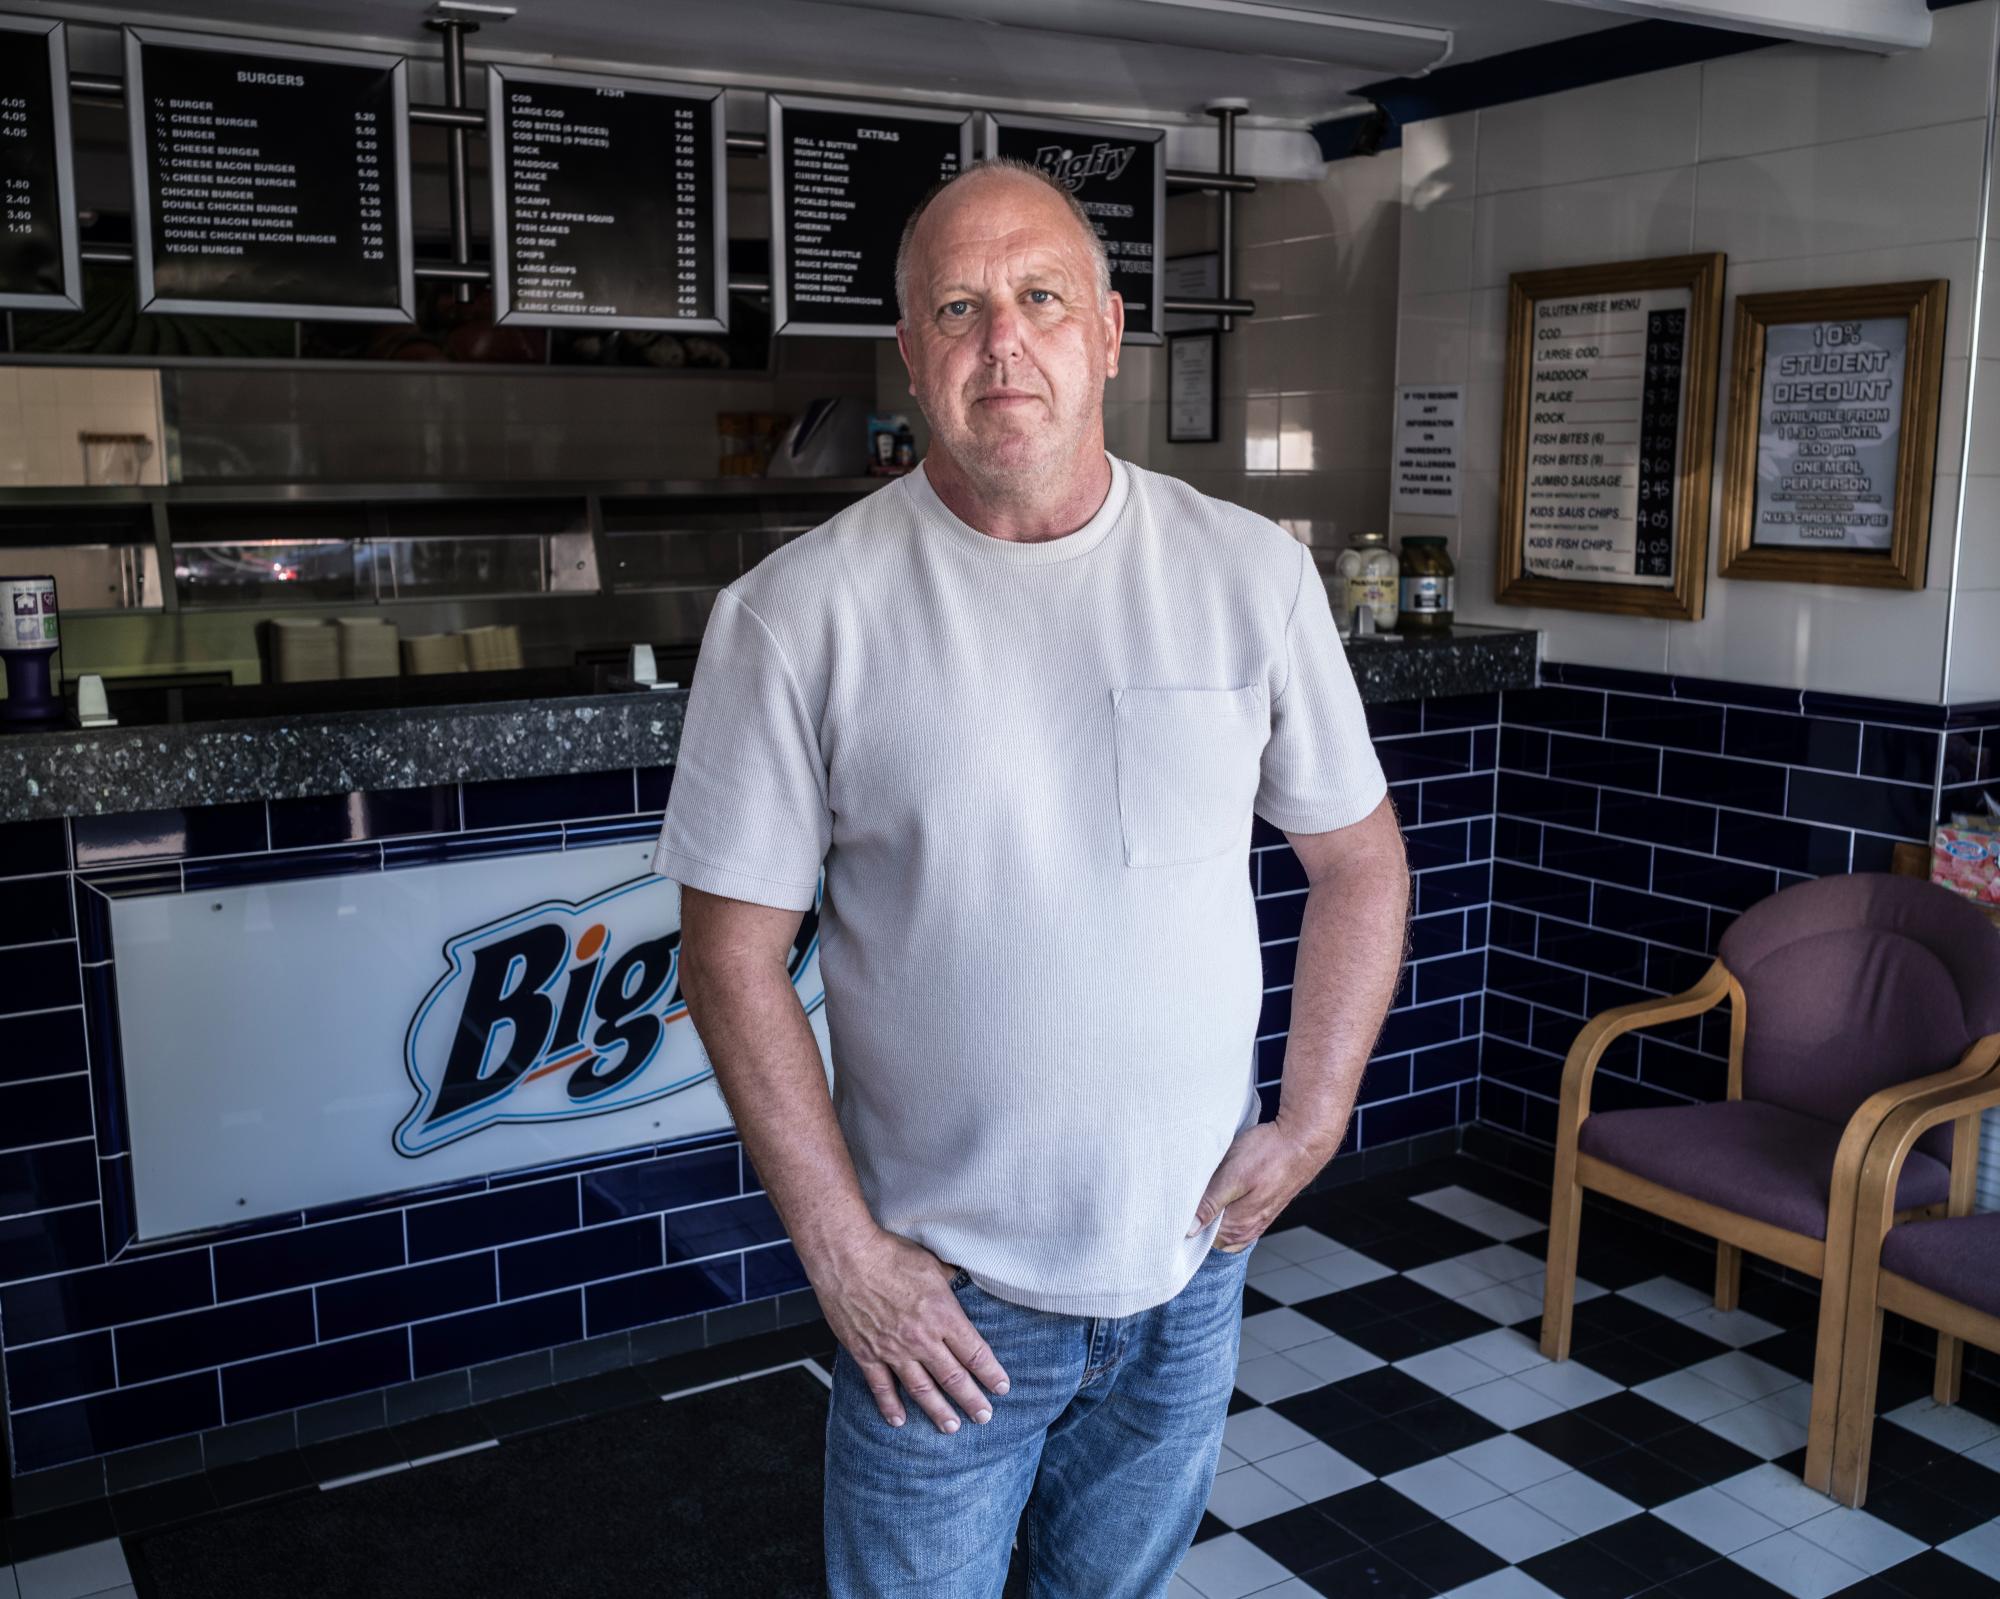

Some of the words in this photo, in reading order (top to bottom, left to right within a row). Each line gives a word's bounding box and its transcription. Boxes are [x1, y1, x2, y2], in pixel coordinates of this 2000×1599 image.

[237, 71, 305, 87] BURGERS
[1, 98, 26, 108] 4.05
[170, 99, 213, 110] BURGER
[511, 94, 532, 103] COD
[2, 111, 26, 121] 4.05
[512, 106, 542, 116] LARGE
[544, 109, 564, 118] COD
[171, 114, 213, 125] CHEESE
[215, 117, 258, 128] BURGER
[512, 120, 532, 128] COD
[534, 122, 561, 131] BITES
[3, 127, 28, 137] 4.05
[172, 129, 215, 140] BURGER
[513, 132, 532, 140] COD
[535, 134, 562, 143] BITES
[857, 129, 899, 141] EXTRAS
[173, 144, 215, 154] CHEESE
[217, 146, 260, 157] BURGER
[513, 146, 540, 154] ROCK
[171, 158, 212, 169] CHEESE
[215, 161, 251, 171] BACON
[254, 163, 296, 173] BURGER
[514, 159, 559, 170] HADDOCK
[172, 173, 214, 183] CHEESE
[216, 175, 252, 185] BACON
[255, 177, 296, 187] BURGER
[514, 171, 547, 181] PLAICE
[161, 187, 208, 198] CHICKEN
[211, 190, 254, 200] BURGER
[514, 183, 540, 192] HAKE
[515, 196, 550, 205] SCAMPI
[794, 198, 828, 206] PICKLED
[162, 200, 204, 210] DOUBLE
[207, 202, 253, 212] CHICKEN
[257, 204, 298, 214] BURGER
[515, 210, 538, 218] SALT
[550, 212, 584, 221] PEPPER
[587, 215, 615, 223] SQUID
[795, 210, 828, 219] PICKLED
[163, 215, 210, 225] CHICKEN
[213, 217, 249, 226] BACON
[252, 218, 293, 228] BURGER
[516, 224, 537, 232] FISH
[539, 225, 570, 234] CAKES
[165, 229, 206, 238] DOUBLE
[210, 231, 256, 241] CHICKEN
[259, 233, 293, 242] BACON
[296, 235, 336, 243] BURGER
[516, 237, 536, 245] COD
[538, 238, 557, 246] ROE
[166, 244, 198, 253] VEGGI
[201, 245, 243, 255] BURGER
[517, 251, 545, 259] CHIPS
[517, 265, 547, 273] LARGE
[549, 266, 576, 274] CHIPS
[518, 278, 539, 286] CHIP
[542, 279, 571, 287] BUTTY
[518, 290, 554, 298] CHEESY
[556, 291, 584, 299] CHIPS
[519, 303, 548, 311] LARGE
[589, 306, 617, 314] CHIPS
[1539, 302, 1579, 318] GLUTEN
[1580, 301, 1607, 313] FREE
[1610, 298, 1641, 311] MENU
[1539, 328, 1561, 340] COD
[1813, 323, 1862, 347] 10%
[1537, 348, 1572, 361] LARGE
[1575, 347, 1599, 358] COD
[1780, 351, 1889, 376] STUDENT
[1536, 369, 1589, 382] HADDOCK
[1536, 391, 1574, 403] PLAICE
[1773, 380, 1892, 403] DISCOUNT
[1535, 413, 1566, 424] ROCK
[1771, 410, 1844, 425] AVAILABLE
[1846, 408, 1889, 424] FROM
[1818, 427, 1840, 439] am
[1842, 425, 1881, 439] UNTIL
[1533, 434, 1557, 445] FISH
[1559, 433, 1589, 444] BITES
[1832, 444, 1856, 456] pm
[1532, 455, 1556, 466] FISH
[1558, 454, 1589, 465] BITES
[1793, 460, 1821, 474] ONE
[1824, 461, 1863, 475] MEAL
[1532, 476, 1569, 487] JUMBO
[1571, 476, 1622, 487] SAUSAGE
[1782, 478, 1810, 490] PER
[1812, 478, 1871, 492] PERSON
[1530, 506, 1554, 516] KIDS
[1557, 507, 1585, 518] SAUS
[1588, 507, 1619, 520] CHIPS
[1795, 512, 1833, 524] CARDS
[1835, 513, 1869, 527] MUST
[1800, 527, 1845, 539] SHOWN
[1529, 537, 1553, 547] KIDS
[1556, 538, 1579, 549] FISH
[1581, 540, 1613, 551] CHIPS
[1529, 557, 1574, 569] VINEGAR
